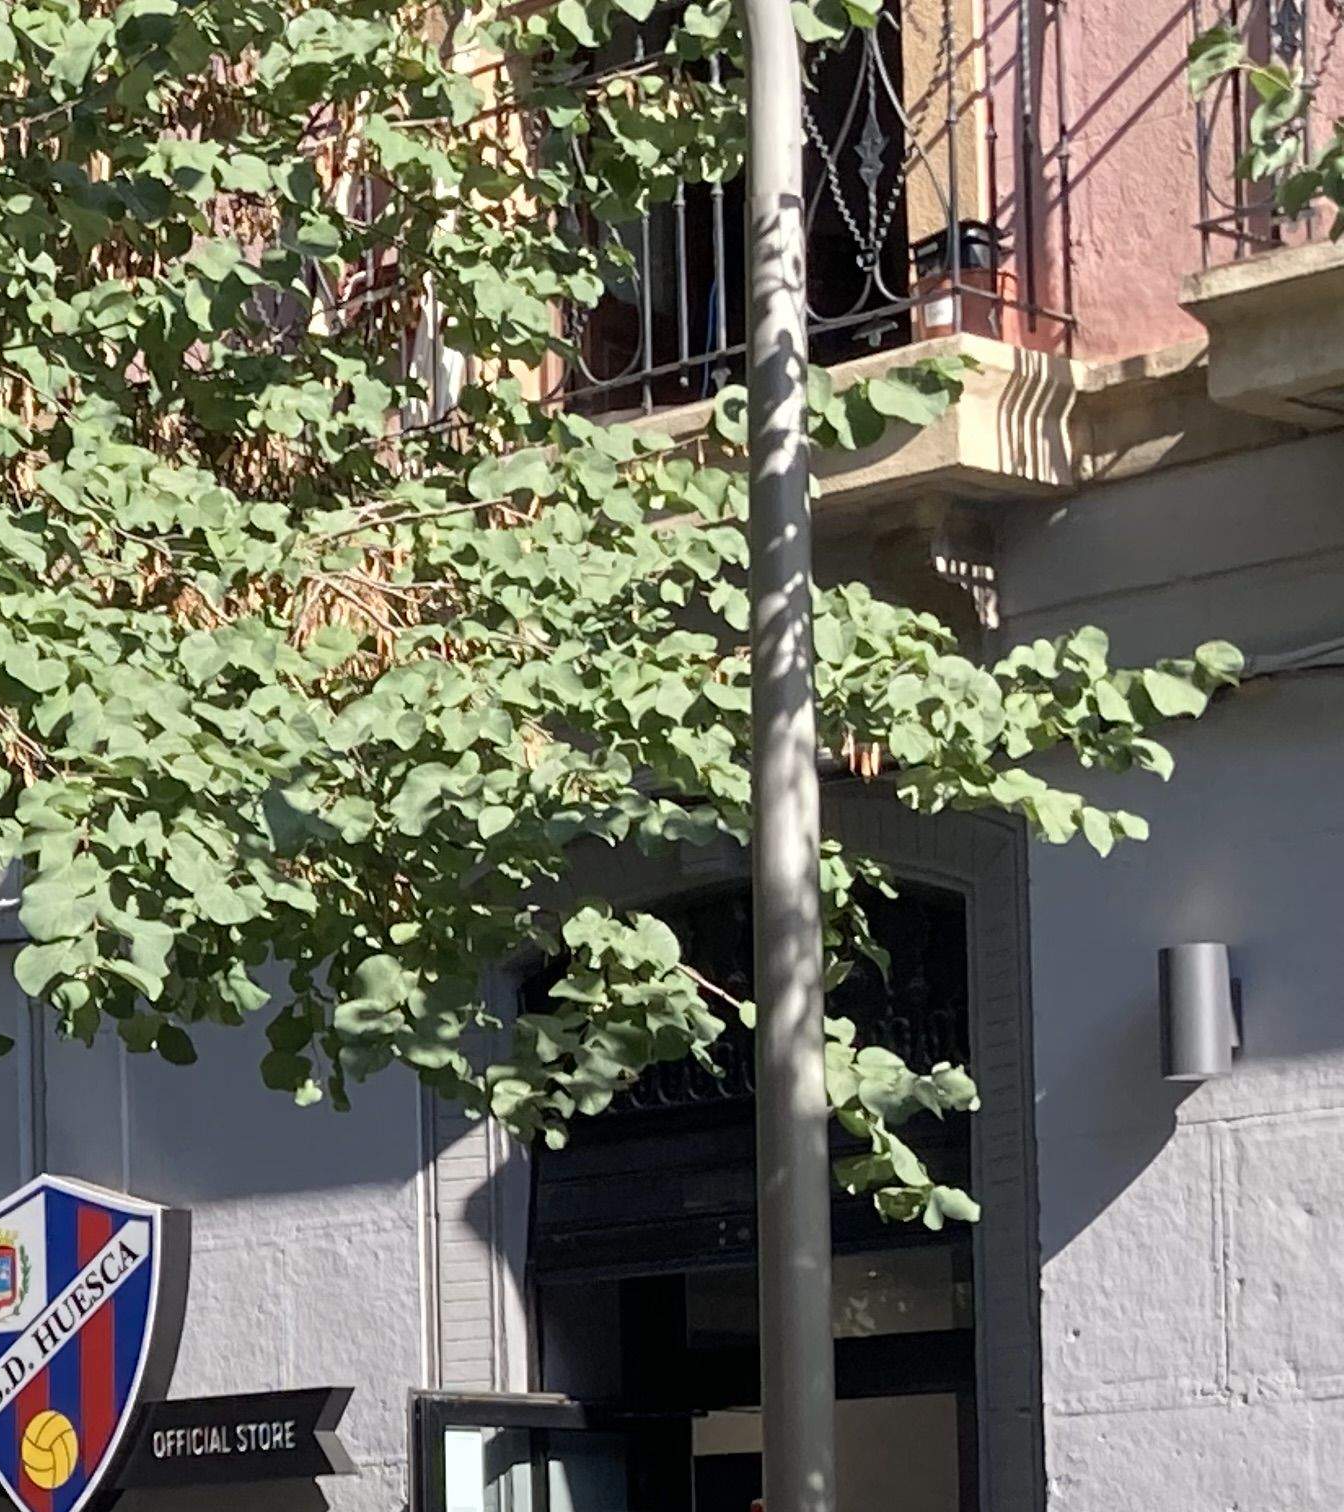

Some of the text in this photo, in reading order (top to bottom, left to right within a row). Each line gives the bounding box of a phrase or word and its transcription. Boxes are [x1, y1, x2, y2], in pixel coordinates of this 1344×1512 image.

[31, 1240, 139, 1359] HUESCA
[153, 1420, 296, 1458] OFFICIAL STORE
